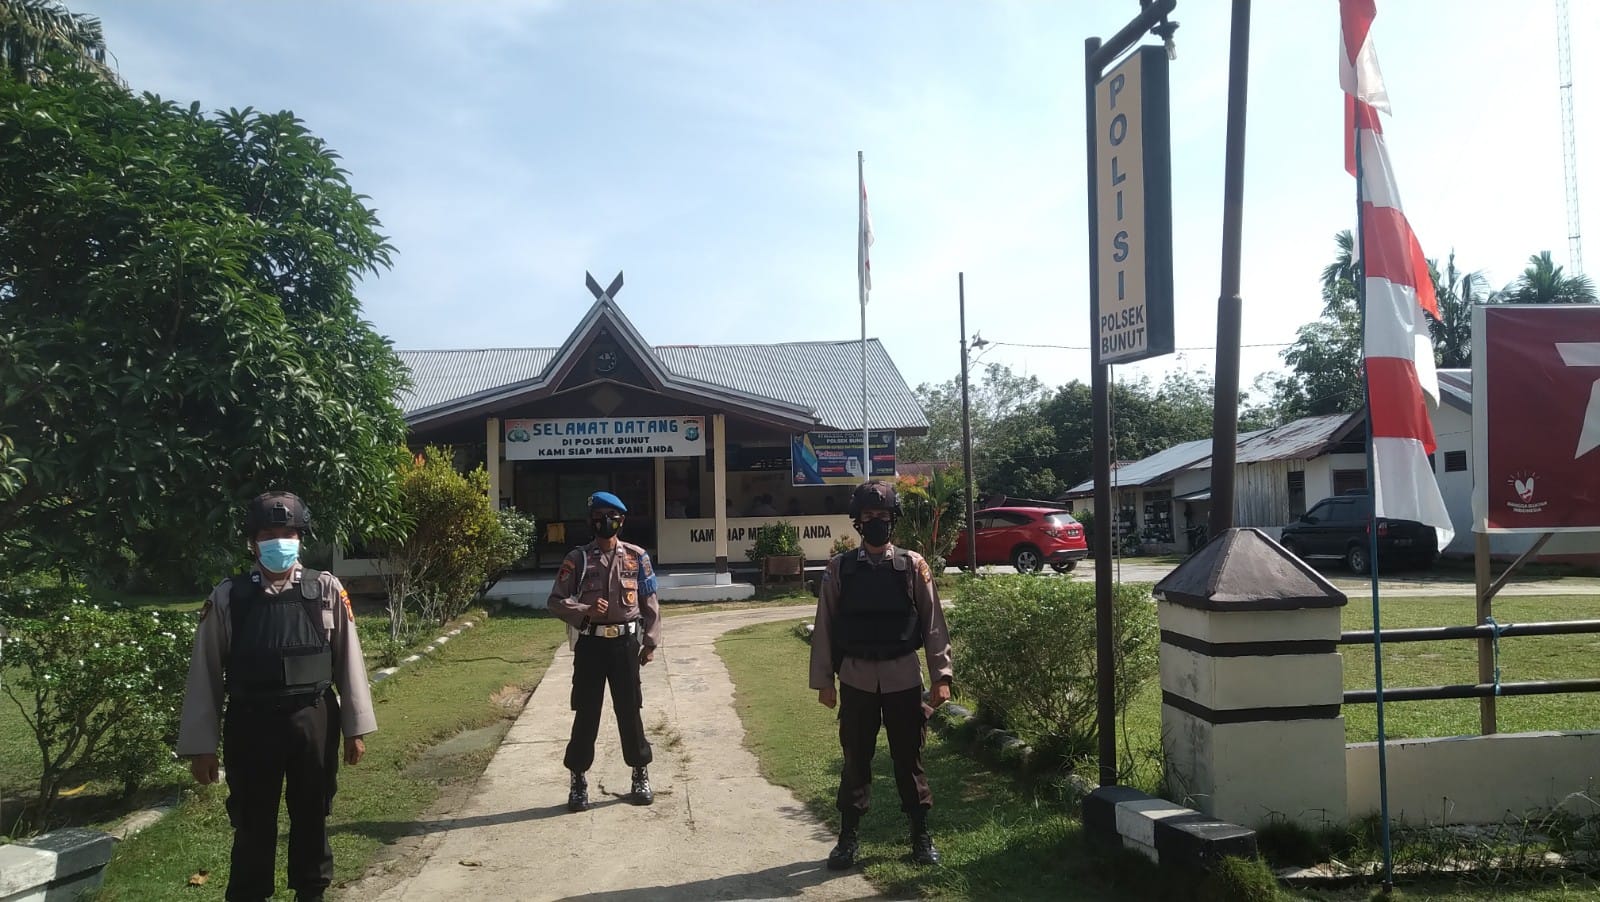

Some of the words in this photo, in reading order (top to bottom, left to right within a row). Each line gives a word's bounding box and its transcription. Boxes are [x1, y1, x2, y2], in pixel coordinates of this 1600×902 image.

[1109, 73, 1129, 301] POLISI
[1101, 305, 1144, 333] POLSEK
[1101, 327, 1145, 354] BUNUT
[533, 421, 609, 436] SELAMAT
[614, 419, 678, 434] DATANG
[562, 439, 572, 447] DI
[575, 437, 614, 446] POLSEK
[617, 436, 650, 445] BUNUT
[538, 448, 565, 457] KAMI
[568, 447, 593, 456] SIAP
[595, 446, 643, 455] MELAYANI
[646, 445, 674, 454] ANDA
[690, 529, 715, 542] KAM
[727, 528, 745, 541] IAP
[803, 525, 832, 539] ANDA
